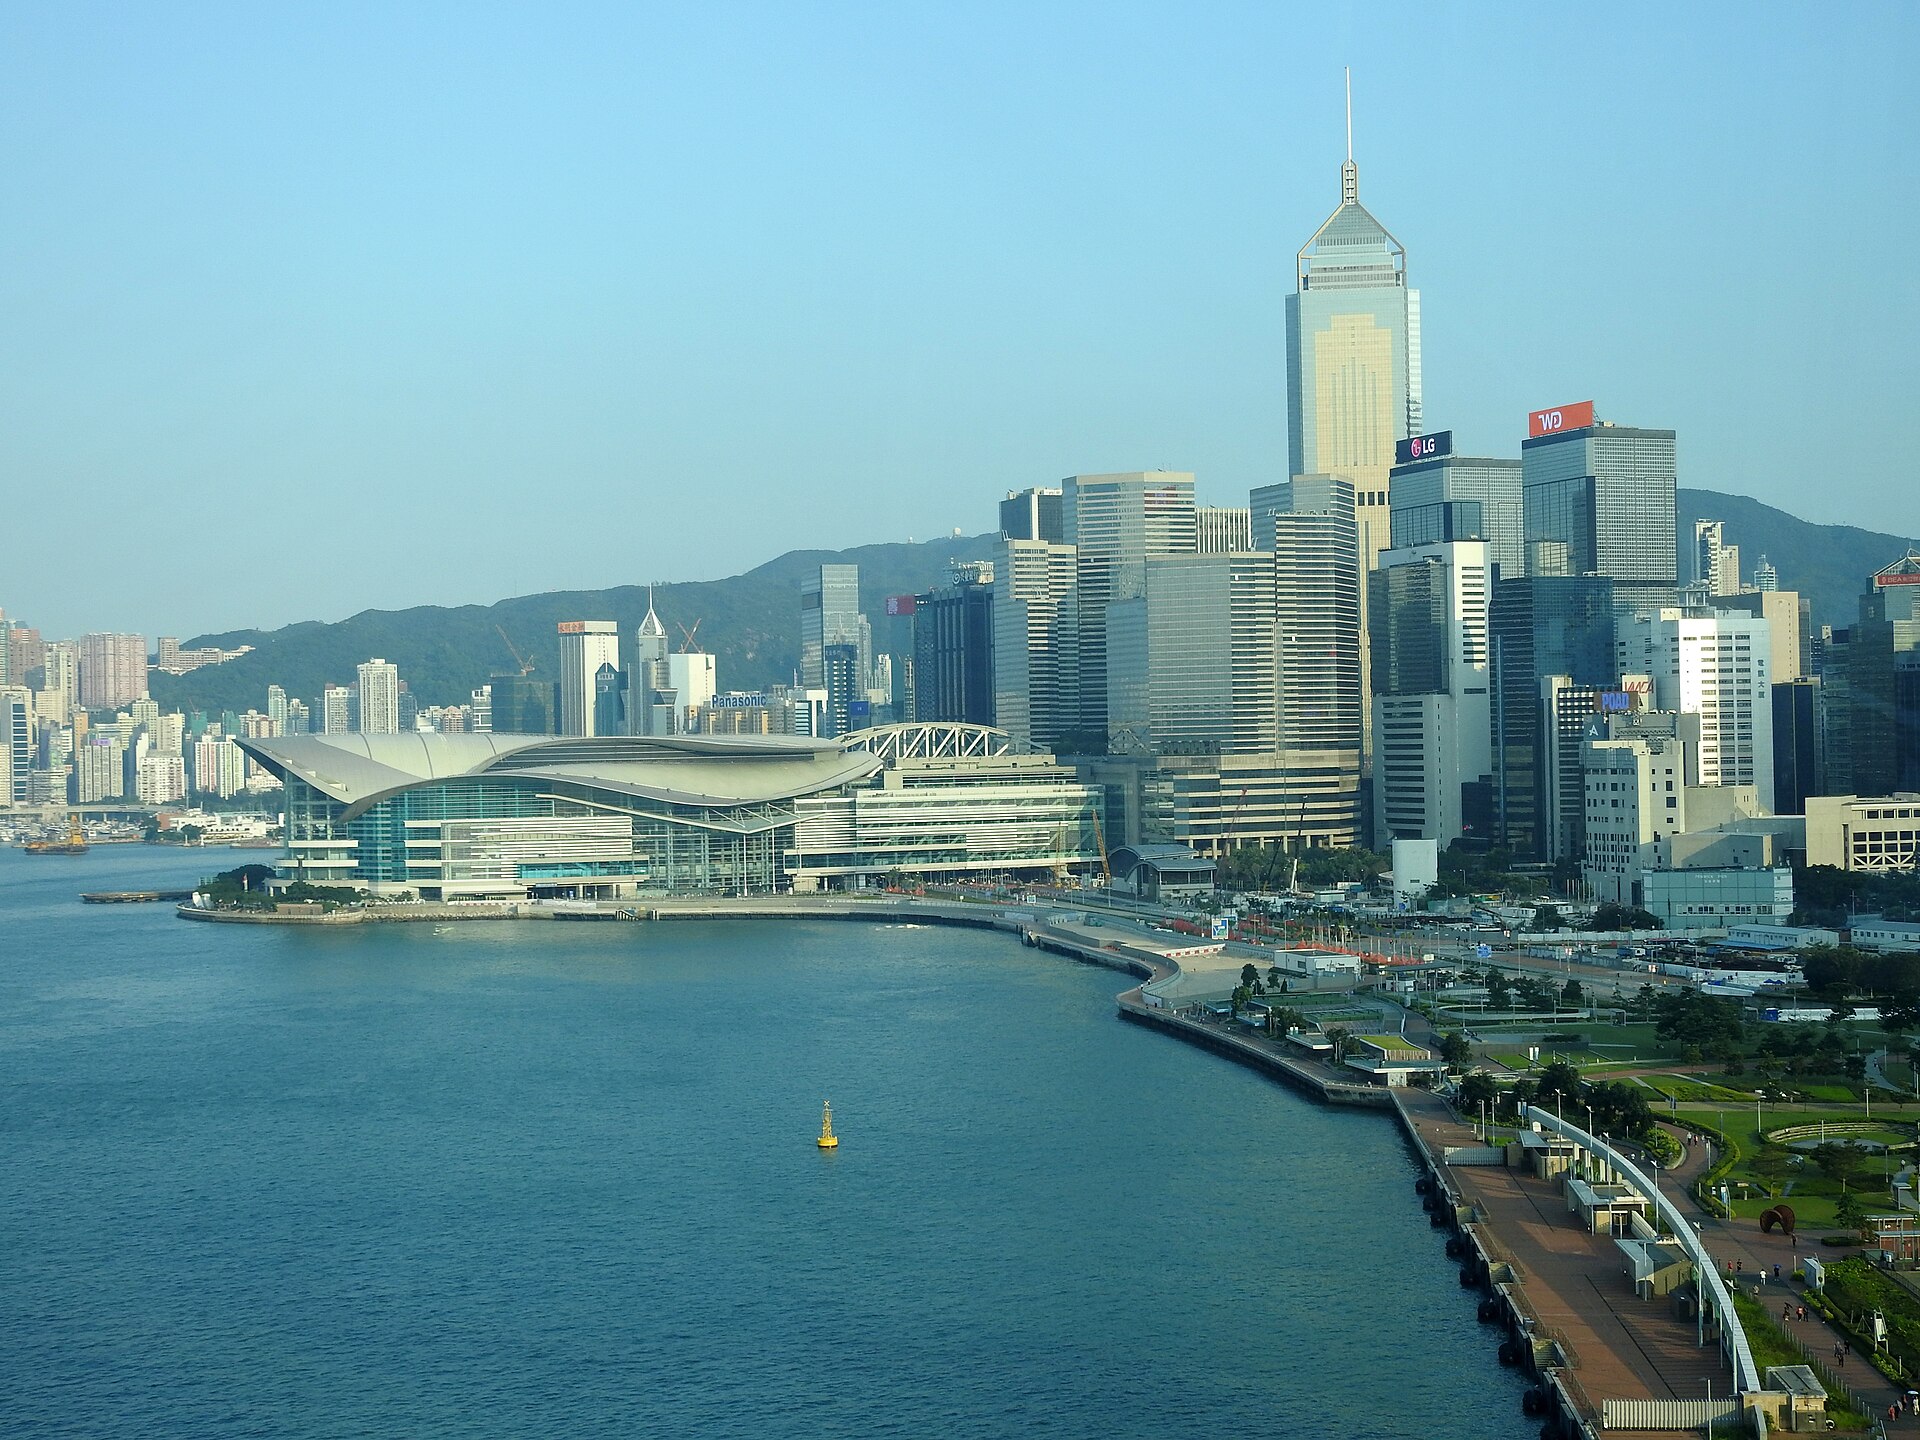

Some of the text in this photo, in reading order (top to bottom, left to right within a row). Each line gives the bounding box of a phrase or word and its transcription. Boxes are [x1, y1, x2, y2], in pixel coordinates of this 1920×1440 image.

[1538, 411, 1562, 431] WD
[1422, 438, 1436, 454] LG
[712, 694, 767, 708] Panasonic
[1602, 692, 1629, 711] POAD
